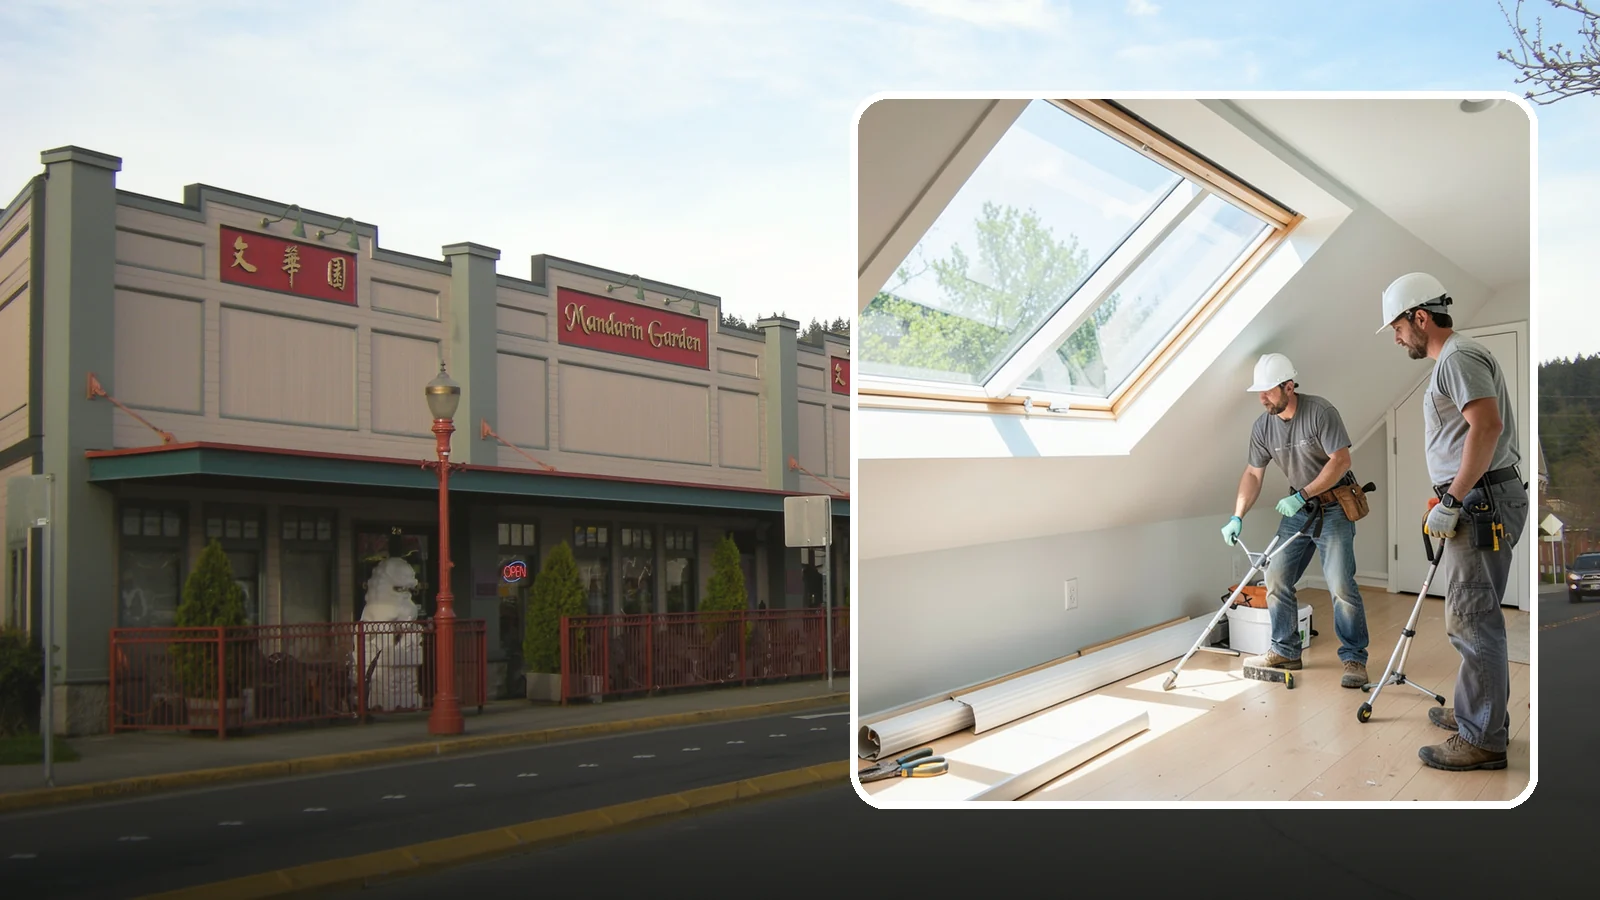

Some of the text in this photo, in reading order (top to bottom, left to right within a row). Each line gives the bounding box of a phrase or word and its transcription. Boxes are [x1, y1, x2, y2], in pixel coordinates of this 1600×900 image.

[230, 236, 346, 292] 文華園
[564, 302, 702, 353] Mandarin Garden
[503, 565, 527, 578] OPEN
